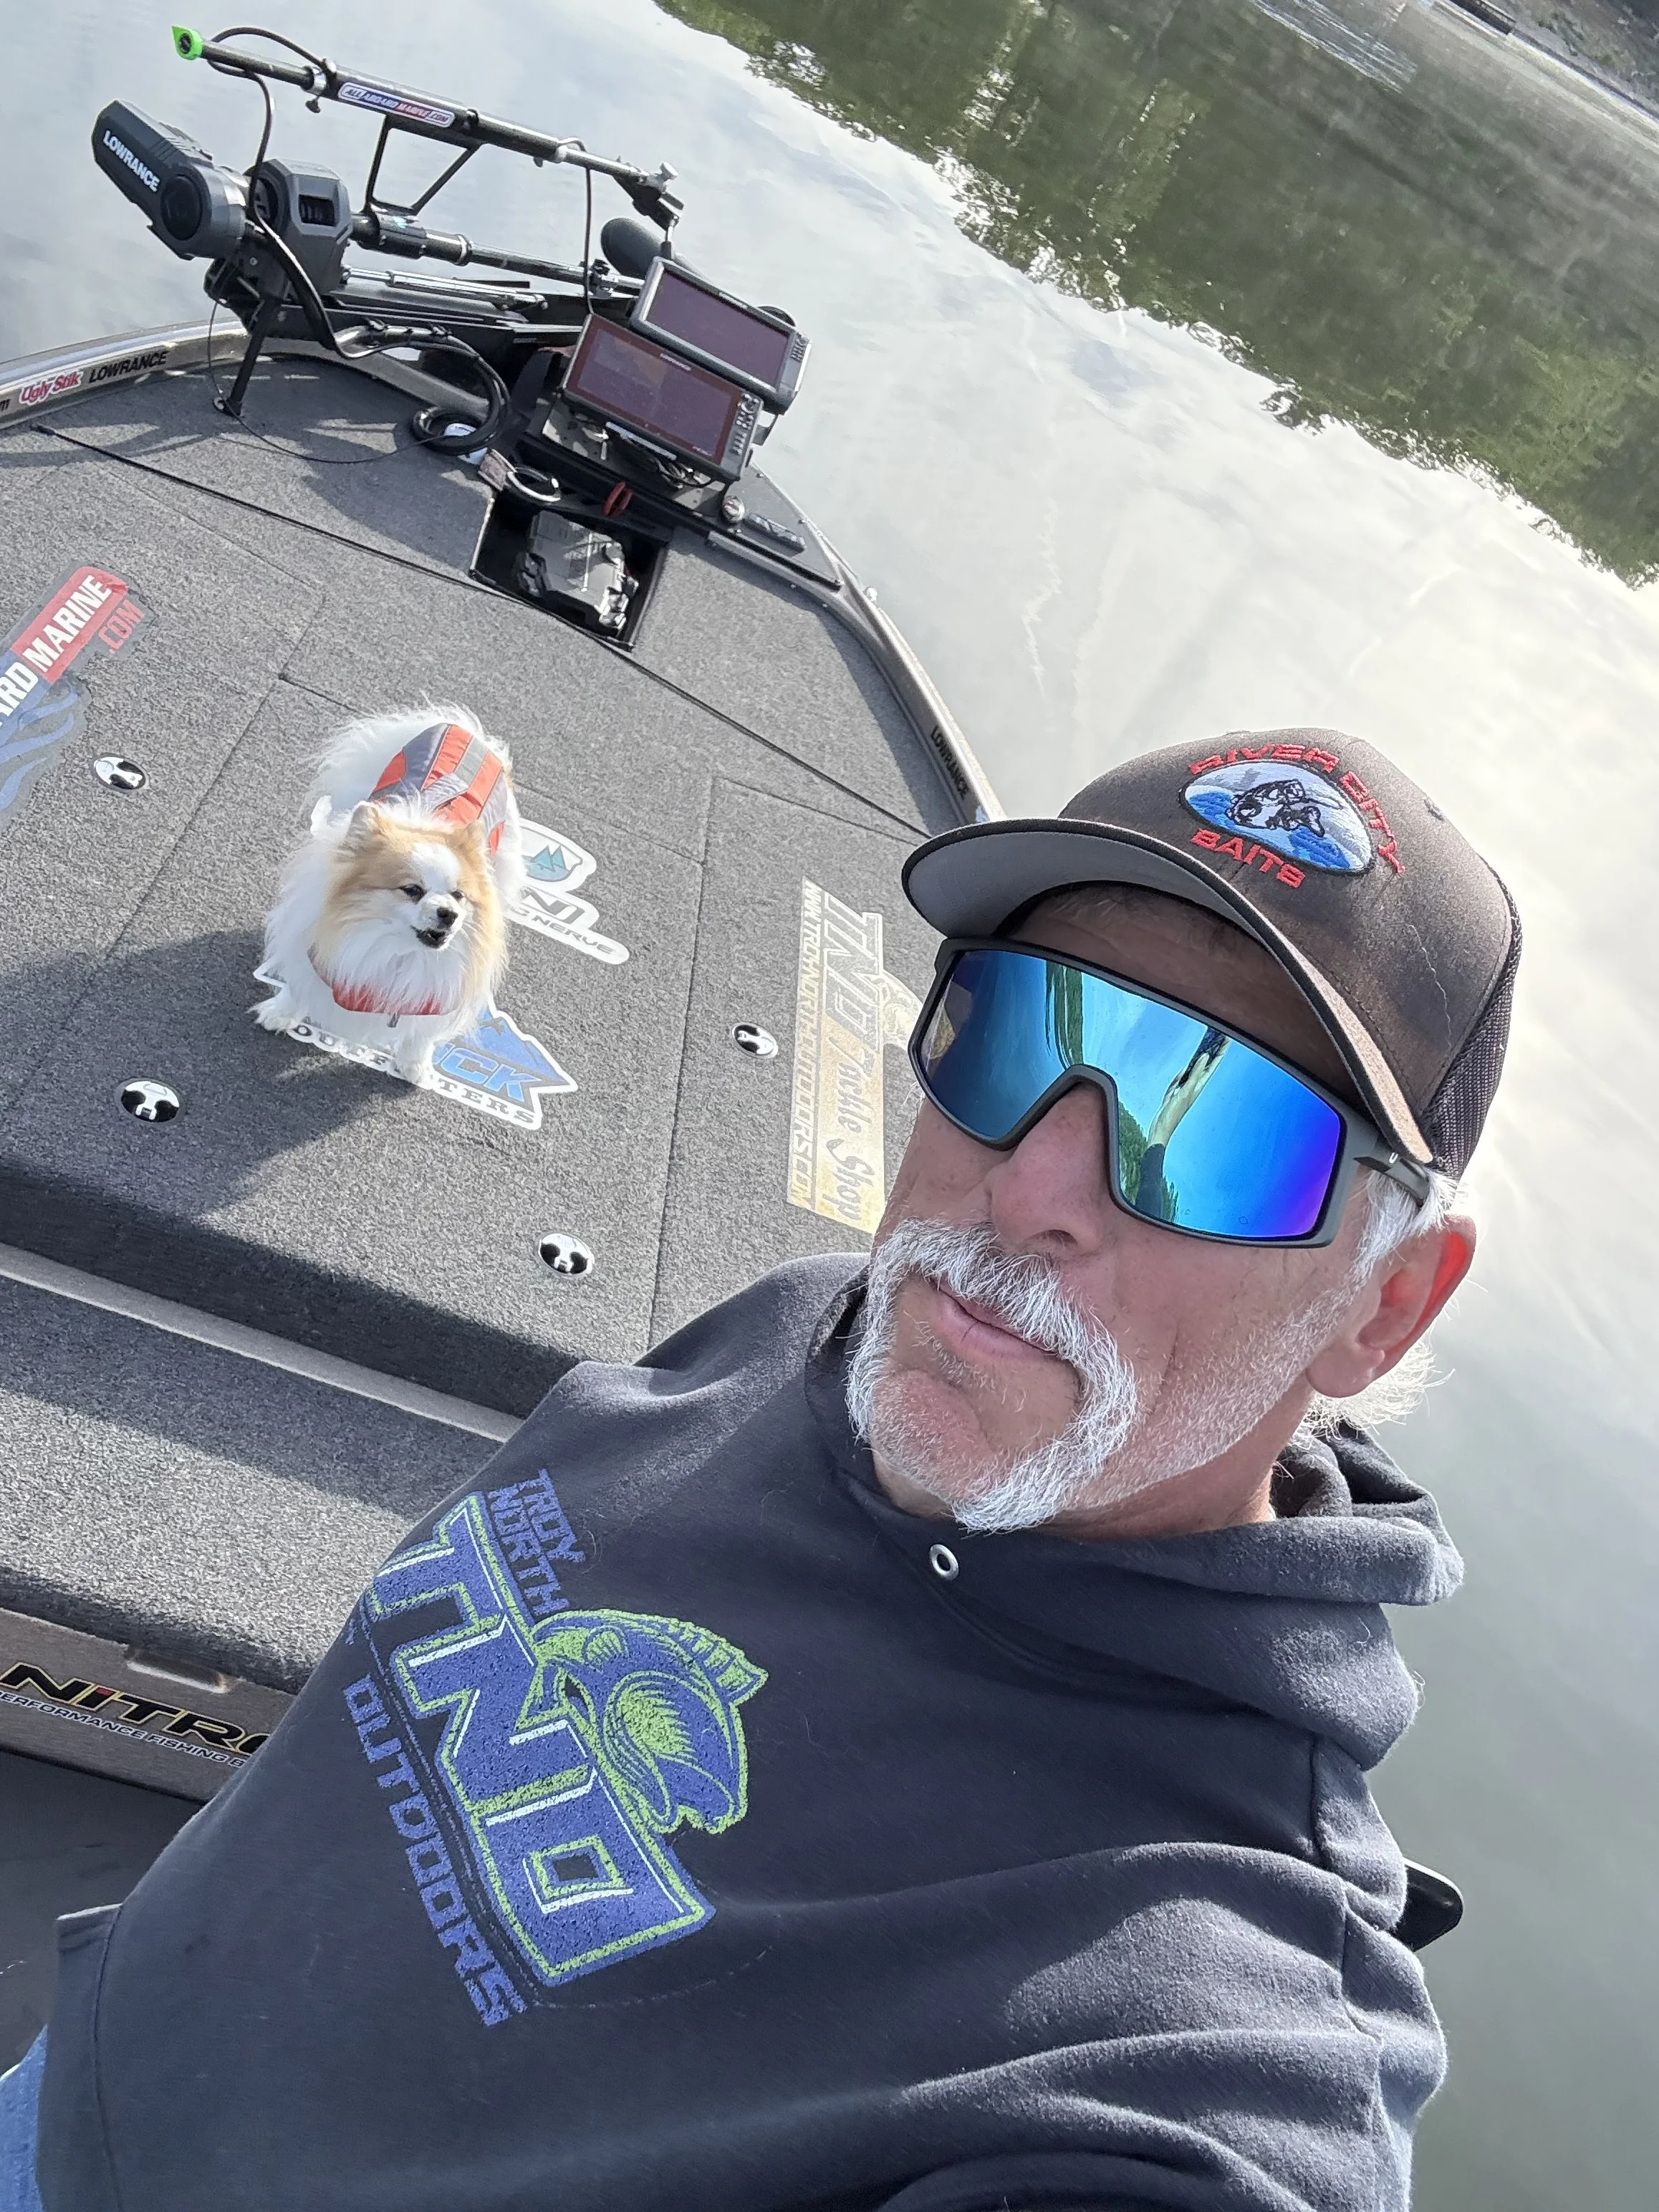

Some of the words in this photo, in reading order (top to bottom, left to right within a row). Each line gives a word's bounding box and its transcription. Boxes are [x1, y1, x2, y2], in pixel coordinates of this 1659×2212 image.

[102, 130, 160, 192] LOWRANCE
[21, 381, 53, 404] Ugly
[52, 371, 80, 393] Stik
[89, 350, 169, 384] LOWRANCE
[23, 575, 112, 673] MARINE
[1188, 744, 1340, 774] RIVER
[1190, 828, 1306, 889] BAITS
[532, 915, 614, 954] NERVE
[827, 1034, 874, 1135] Tackle
[823, 1138, 874, 1221] Shop
[488, 1484, 569, 1615] NORTH
[518, 1468, 585, 1562] TROY
[0, 1691, 148, 1739] ERFORMANCE
[146, 1733, 229, 1763] FISHING
[343, 1673, 526, 2026] OUTDOORS
